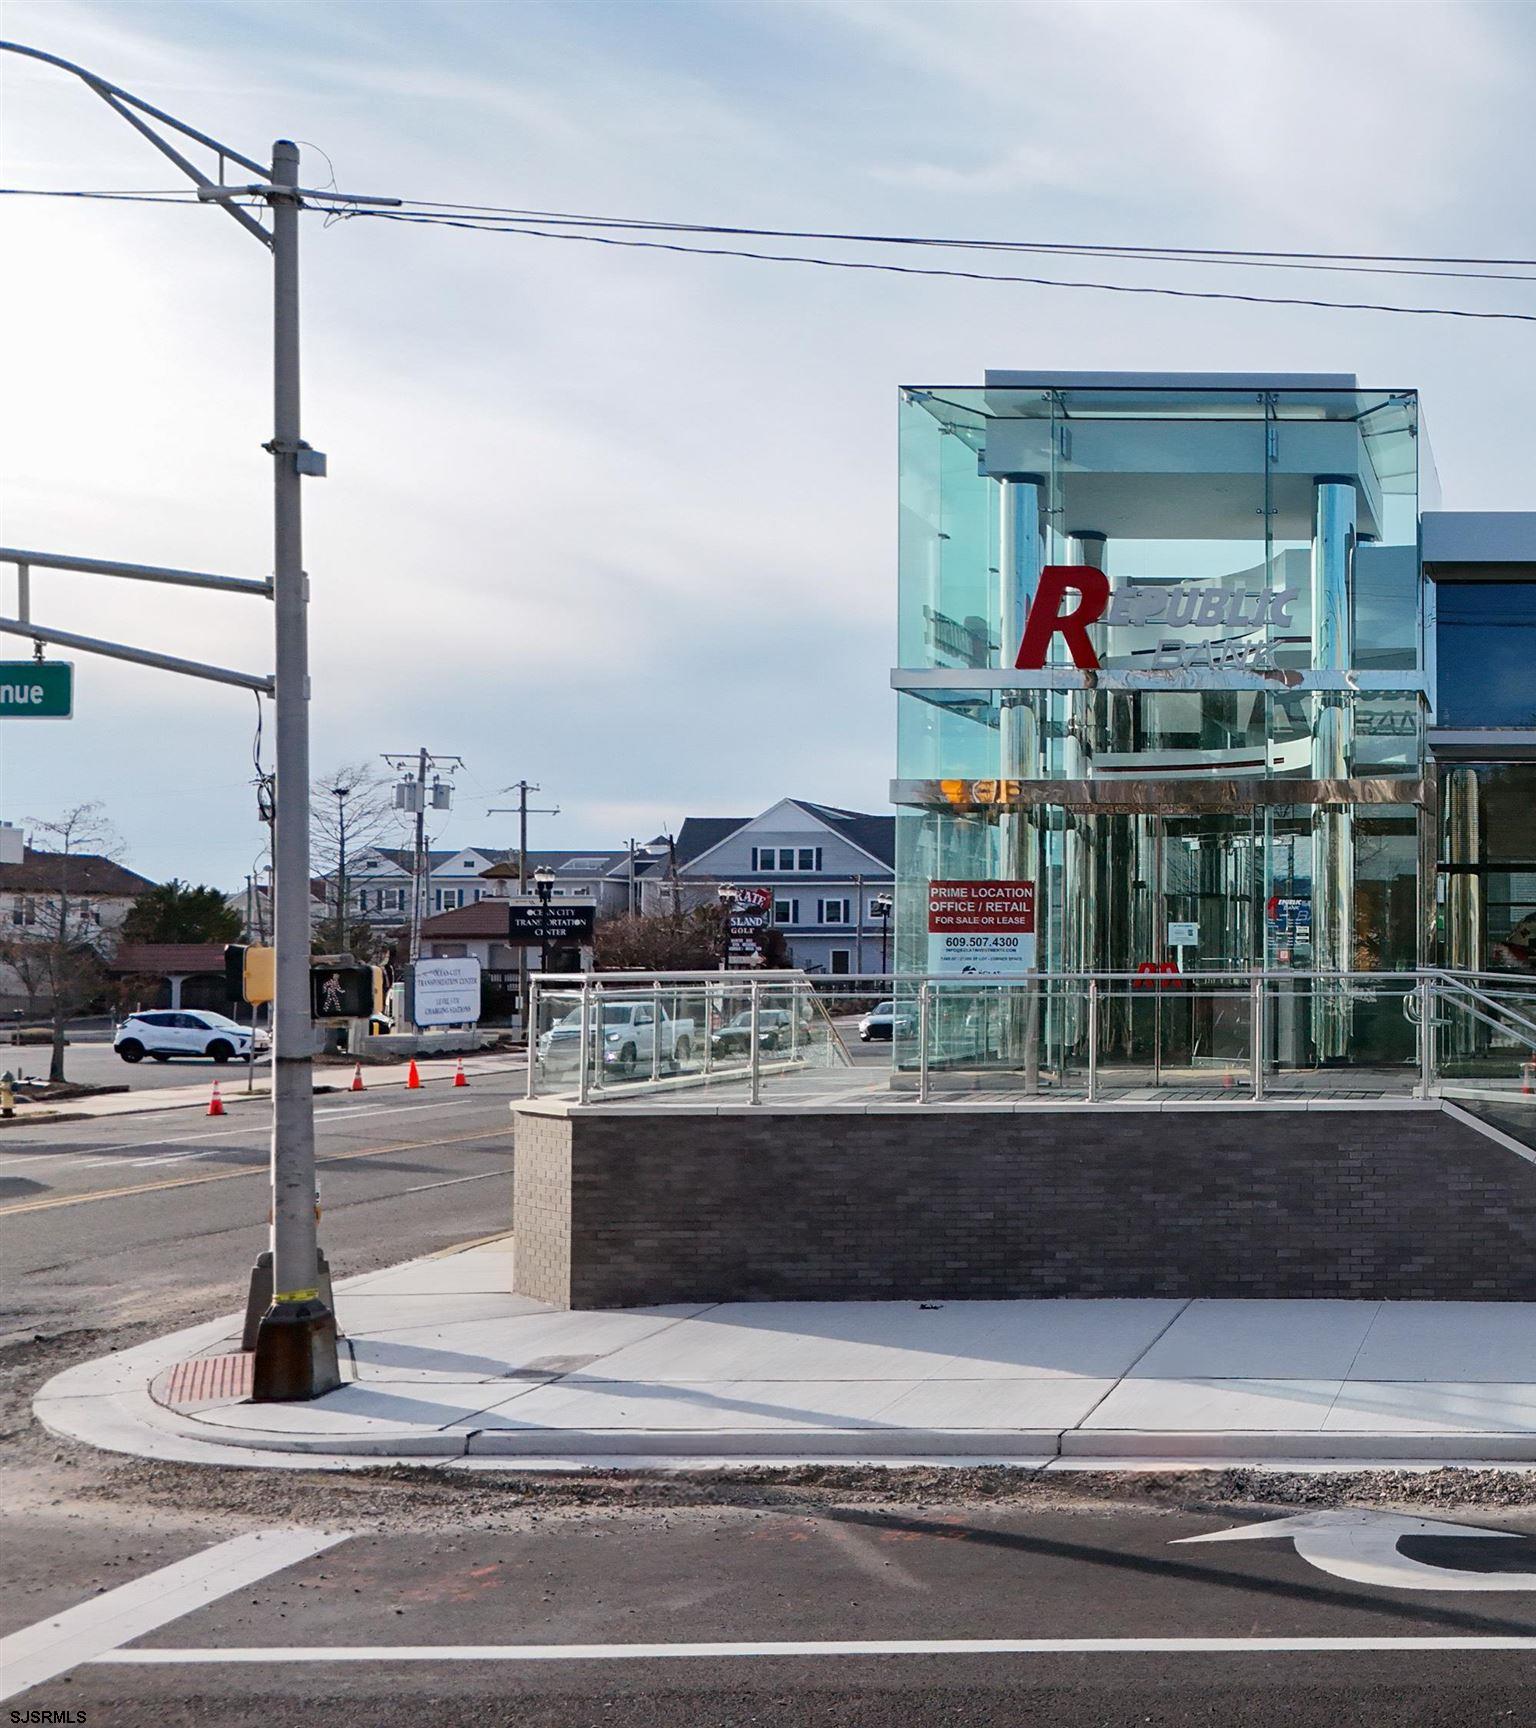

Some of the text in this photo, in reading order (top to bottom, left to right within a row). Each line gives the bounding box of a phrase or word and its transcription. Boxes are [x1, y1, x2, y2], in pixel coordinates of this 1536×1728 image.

[1015, 565, 1298, 670] REPUBLIC
[1152, 638, 1285, 670] BANK
[0, 684, 44, 704] nue
[930, 888, 1033, 898] PRIME LOCATION
[929, 902, 1031, 912] OFFICE / RETAIL
[946, 937, 1019, 947] 609.507.4300
